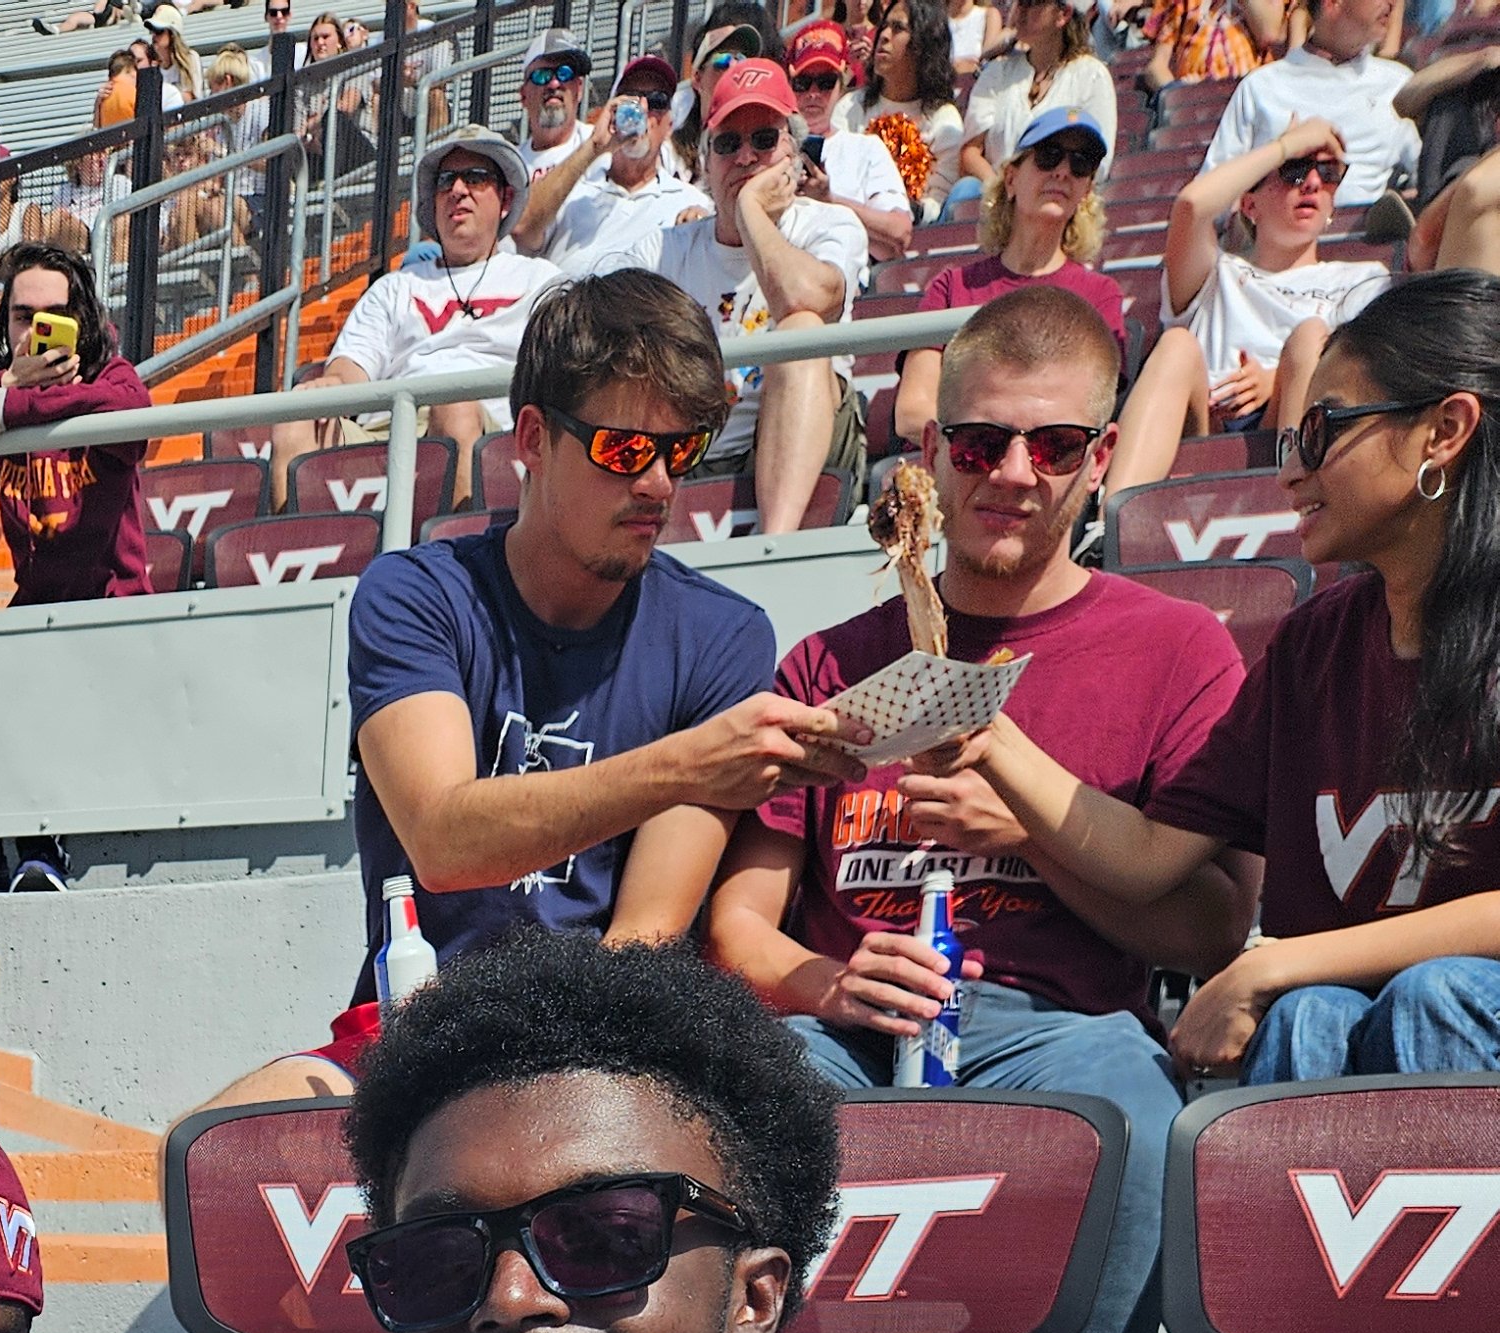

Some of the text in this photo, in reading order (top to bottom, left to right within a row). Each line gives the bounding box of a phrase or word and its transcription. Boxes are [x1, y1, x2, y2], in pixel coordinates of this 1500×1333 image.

[732, 67, 773, 88] VT
[147, 489, 235, 543] VT
[1163, 510, 1302, 562] VT
[246, 544, 346, 588] VT
[833, 789, 940, 850] COA
[843, 853, 1040, 884] ONE LAST THIN
